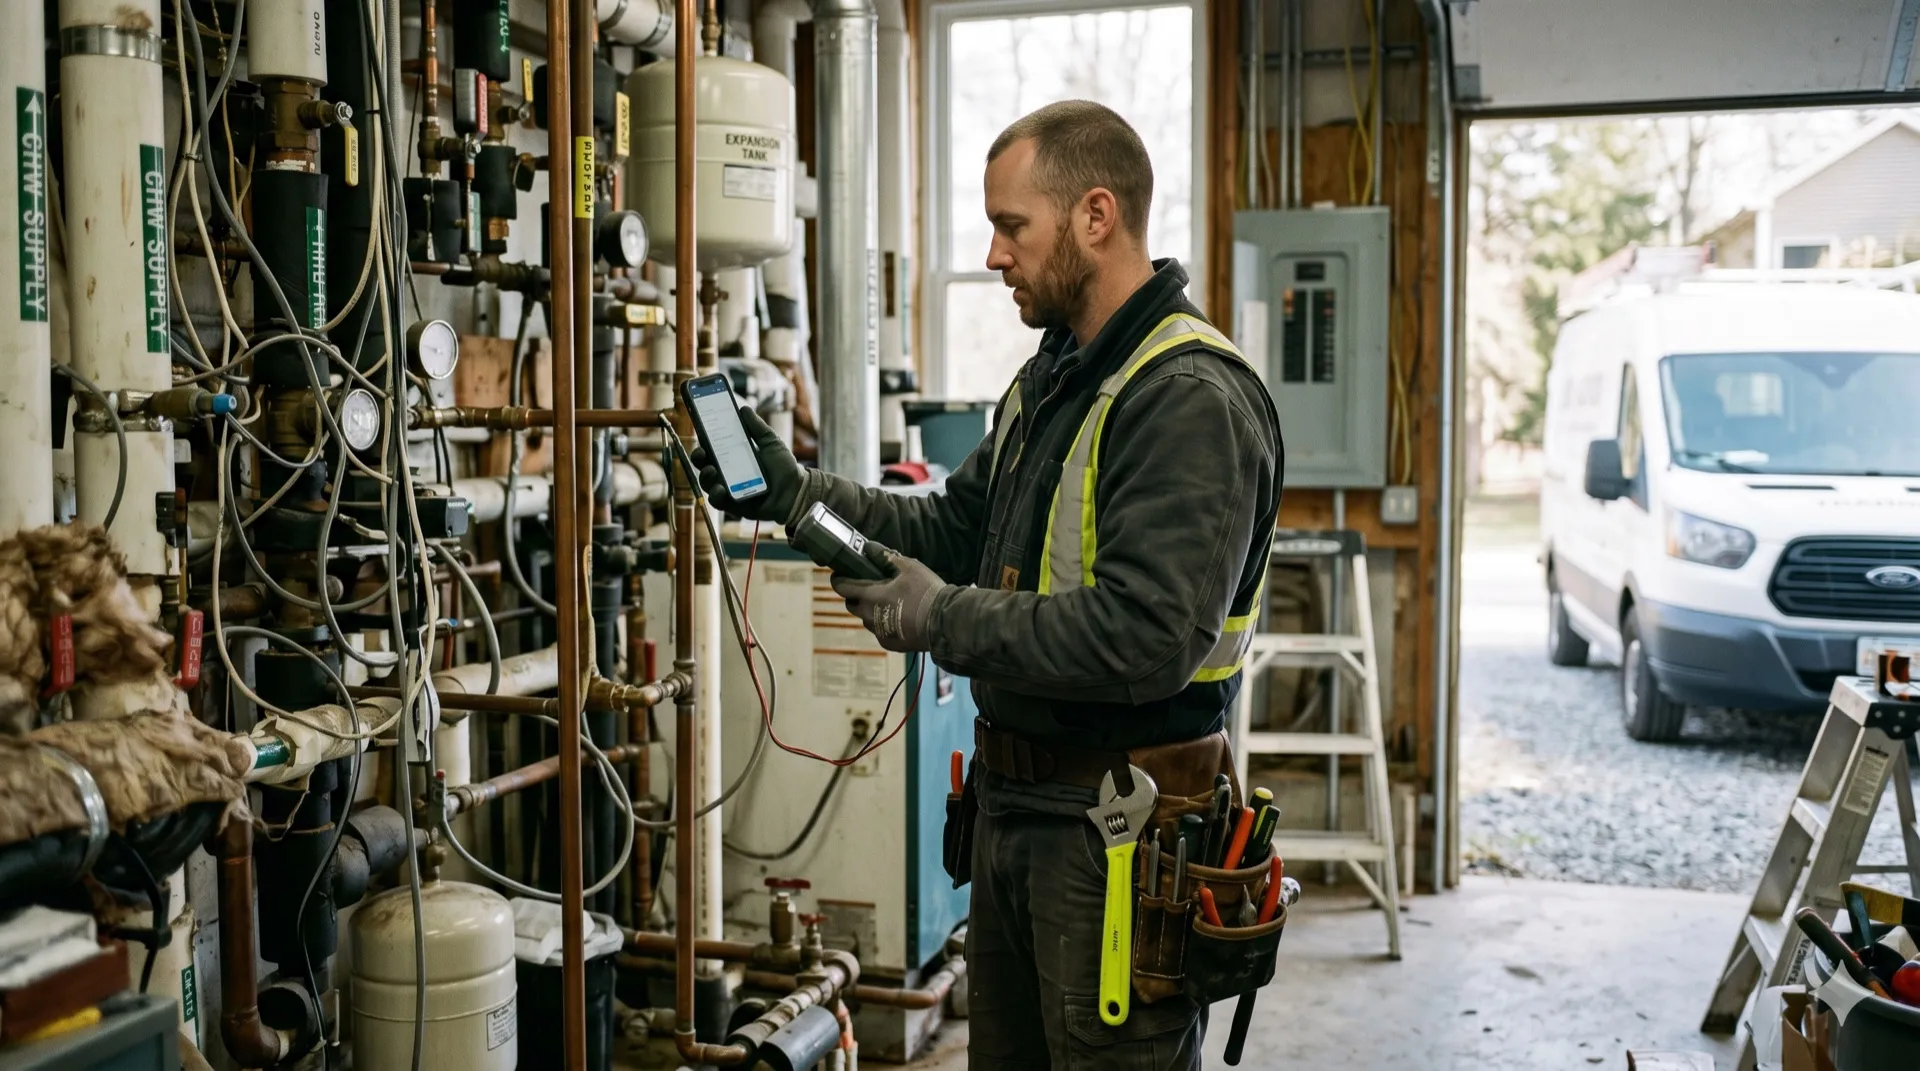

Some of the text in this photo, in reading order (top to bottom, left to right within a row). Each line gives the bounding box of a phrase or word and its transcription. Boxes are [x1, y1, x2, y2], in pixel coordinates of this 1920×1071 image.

[725, 133, 781, 150] EXPANSION
[742, 147, 768, 162] TANK
[22, 132, 46, 313] CHW SUPPLY
[144, 170, 167, 337] CHW SUPPLY
